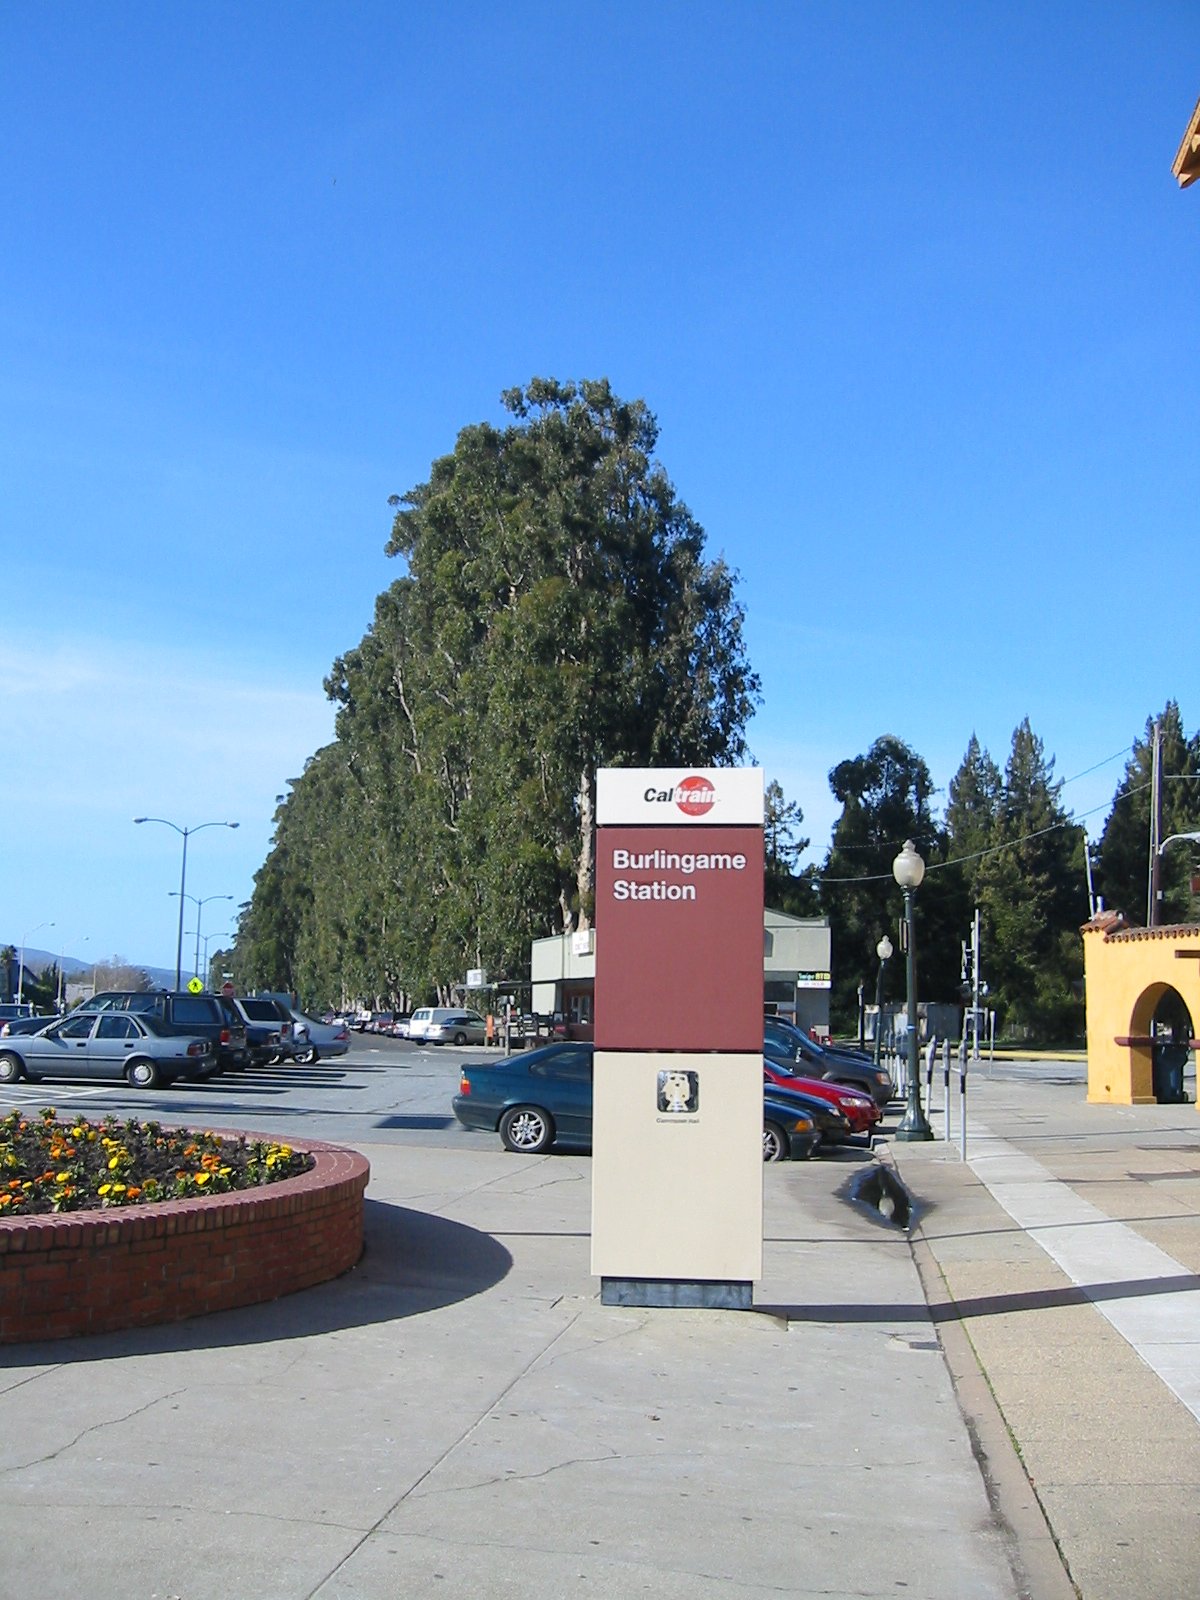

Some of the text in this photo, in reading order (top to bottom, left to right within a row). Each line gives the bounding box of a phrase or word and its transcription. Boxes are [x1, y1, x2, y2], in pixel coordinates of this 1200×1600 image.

[643, 786, 717, 803] Caltrain
[613, 850, 746, 873] Burlingame
[613, 880, 696, 900] Station
